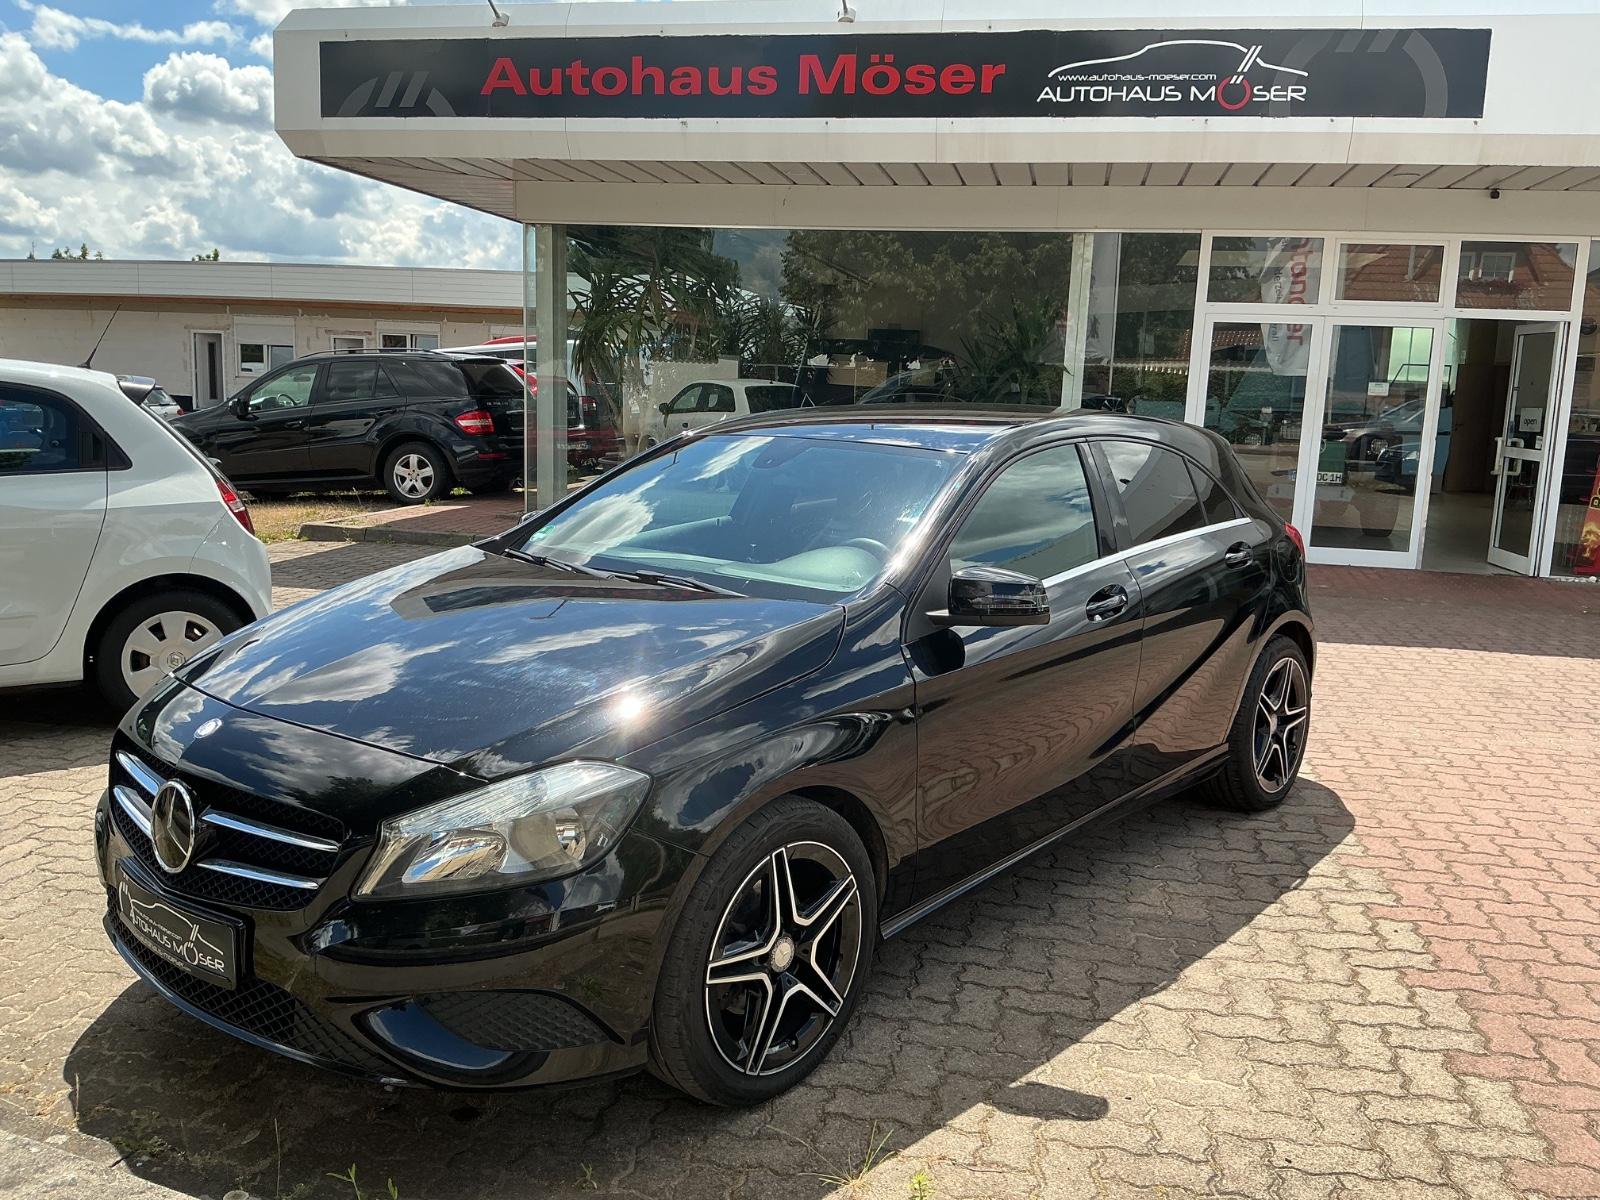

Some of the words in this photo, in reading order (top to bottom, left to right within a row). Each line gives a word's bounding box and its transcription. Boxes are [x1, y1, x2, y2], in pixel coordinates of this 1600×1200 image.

[481, 56, 777, 96] Autohaus
[799, 54, 1006, 95] Möser
[1037, 85, 1182, 102] AUTOHAUS
[1190, 75, 1308, 110] MÖSER
[1058, 73, 1217, 81] www.autohaus-moeser.com
[1523, 418, 1538, 427] open
[130, 908, 171, 949] AUTOHAUS
[173, 941, 225, 973] MÖSER
